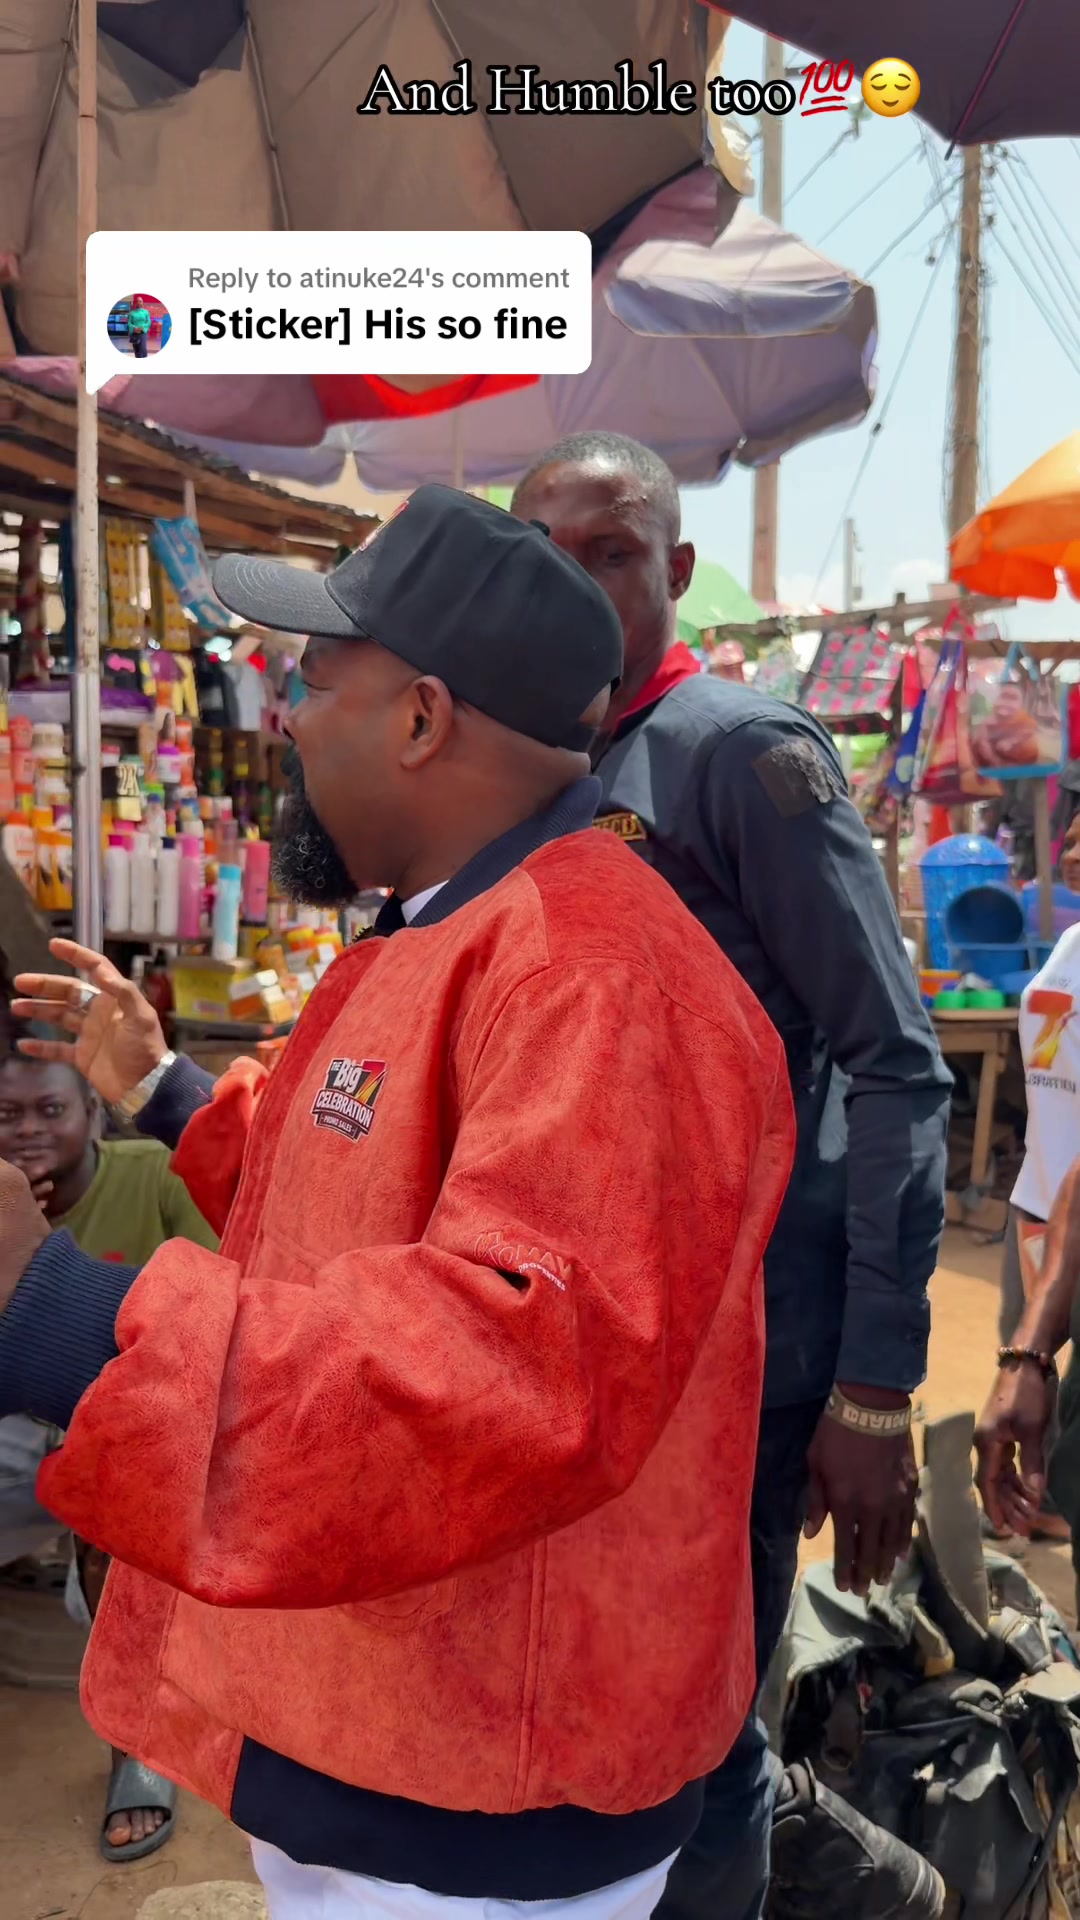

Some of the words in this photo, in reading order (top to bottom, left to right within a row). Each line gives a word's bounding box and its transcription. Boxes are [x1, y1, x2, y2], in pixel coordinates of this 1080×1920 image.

[355, 1060, 386, 1105] 7
[316, 1091, 374, 1128] CELEBRATION
[338, 1120, 353, 1132] SALES
